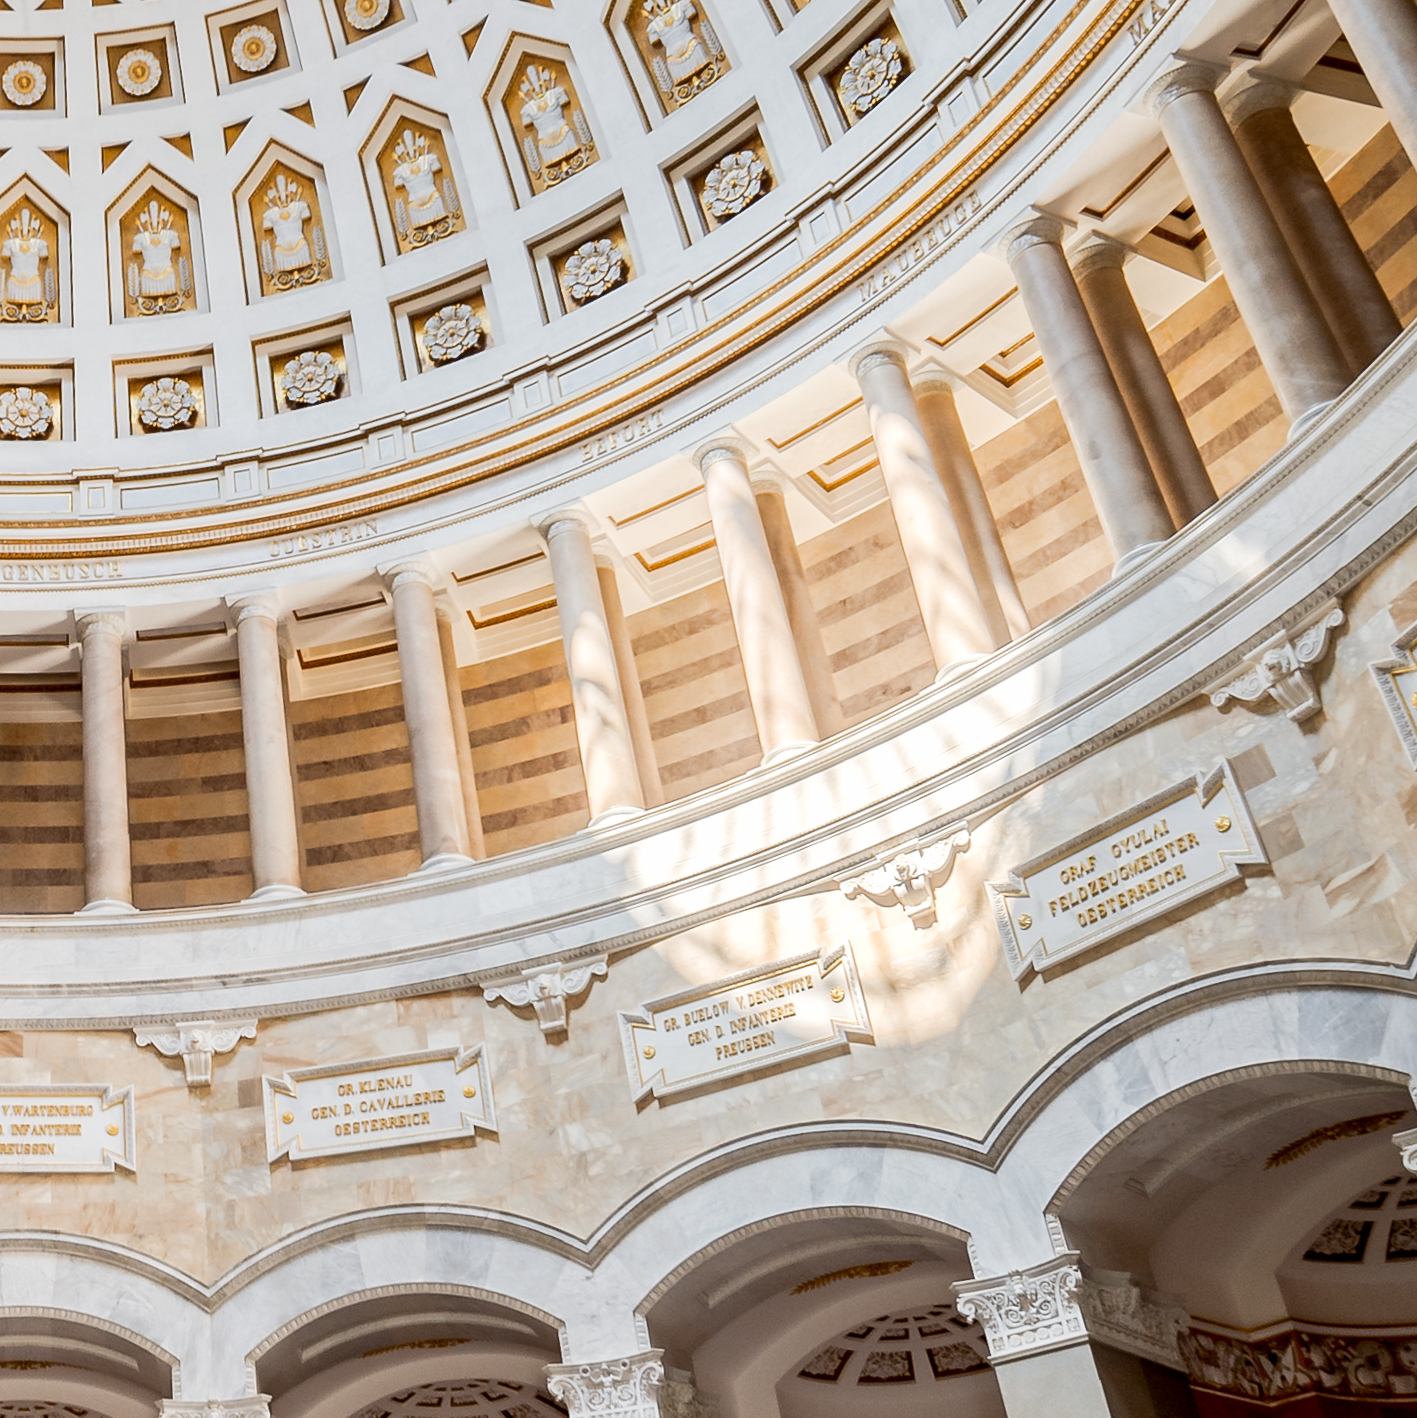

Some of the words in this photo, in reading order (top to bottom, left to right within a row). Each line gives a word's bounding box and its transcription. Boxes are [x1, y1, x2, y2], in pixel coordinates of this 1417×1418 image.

[856, 189, 982, 302] MAUBEUGE
[1059, 854, 1097, 885] GRAF
[1111, 818, 1170, 859] GYULAI
[1048, 831, 1200, 918] FELDZEUGMEISTER
[1076, 863, 1187, 928] OESTERREICH
[683, 1000, 729, 1027] BUELOW
[748, 974, 814, 1008] DENNEWITZ
[729, 1002, 796, 1035] INFANTERIE
[715, 1030, 776, 1061] PREUSSEN
[360, 1089, 446, 1113] CAVALLERIE
[11, 1123, 82, 1136] INFANTERIE
[334, 1111, 431, 1137] OESTERREICH
